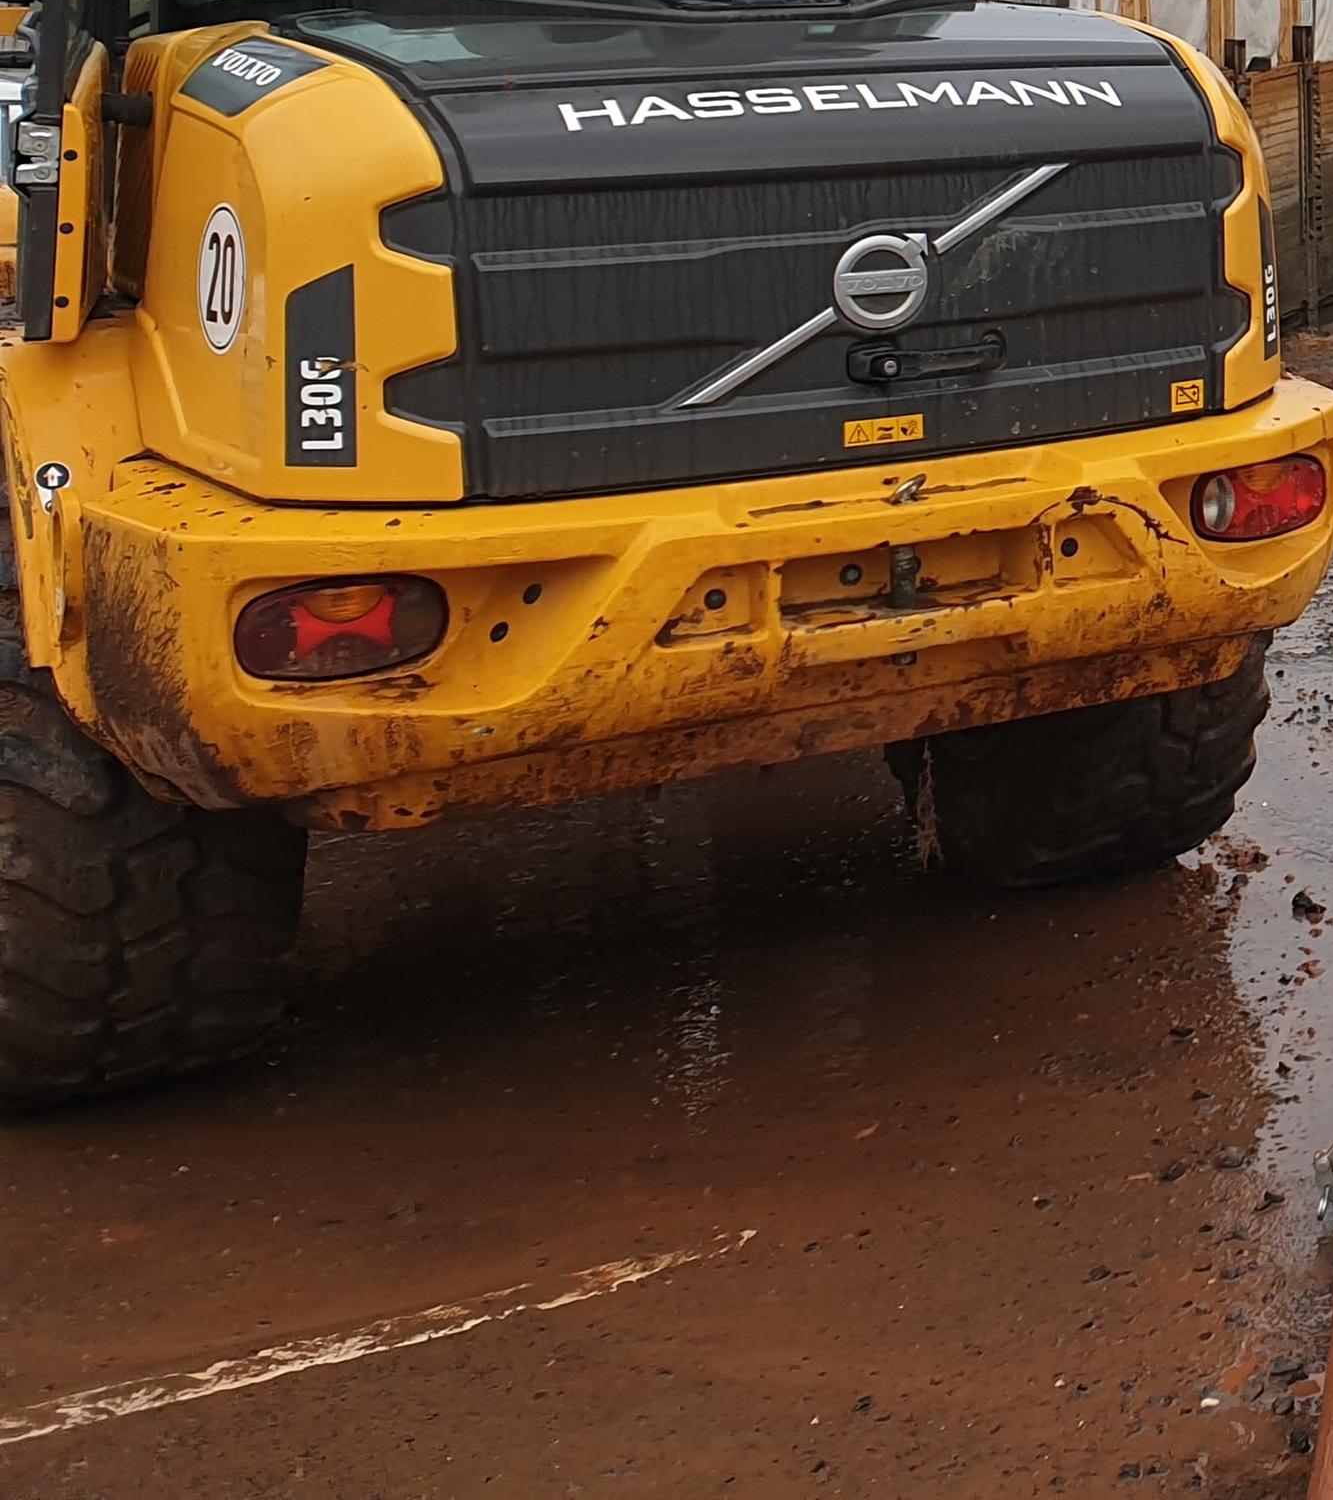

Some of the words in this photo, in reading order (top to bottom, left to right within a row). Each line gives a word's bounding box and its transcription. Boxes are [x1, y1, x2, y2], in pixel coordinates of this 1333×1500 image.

[212, 48, 282, 86] VOLVO
[557, 80, 1123, 132] HASSELMANN
[206, 232, 235, 325] 20
[1265, 264, 1276, 342] L30G
